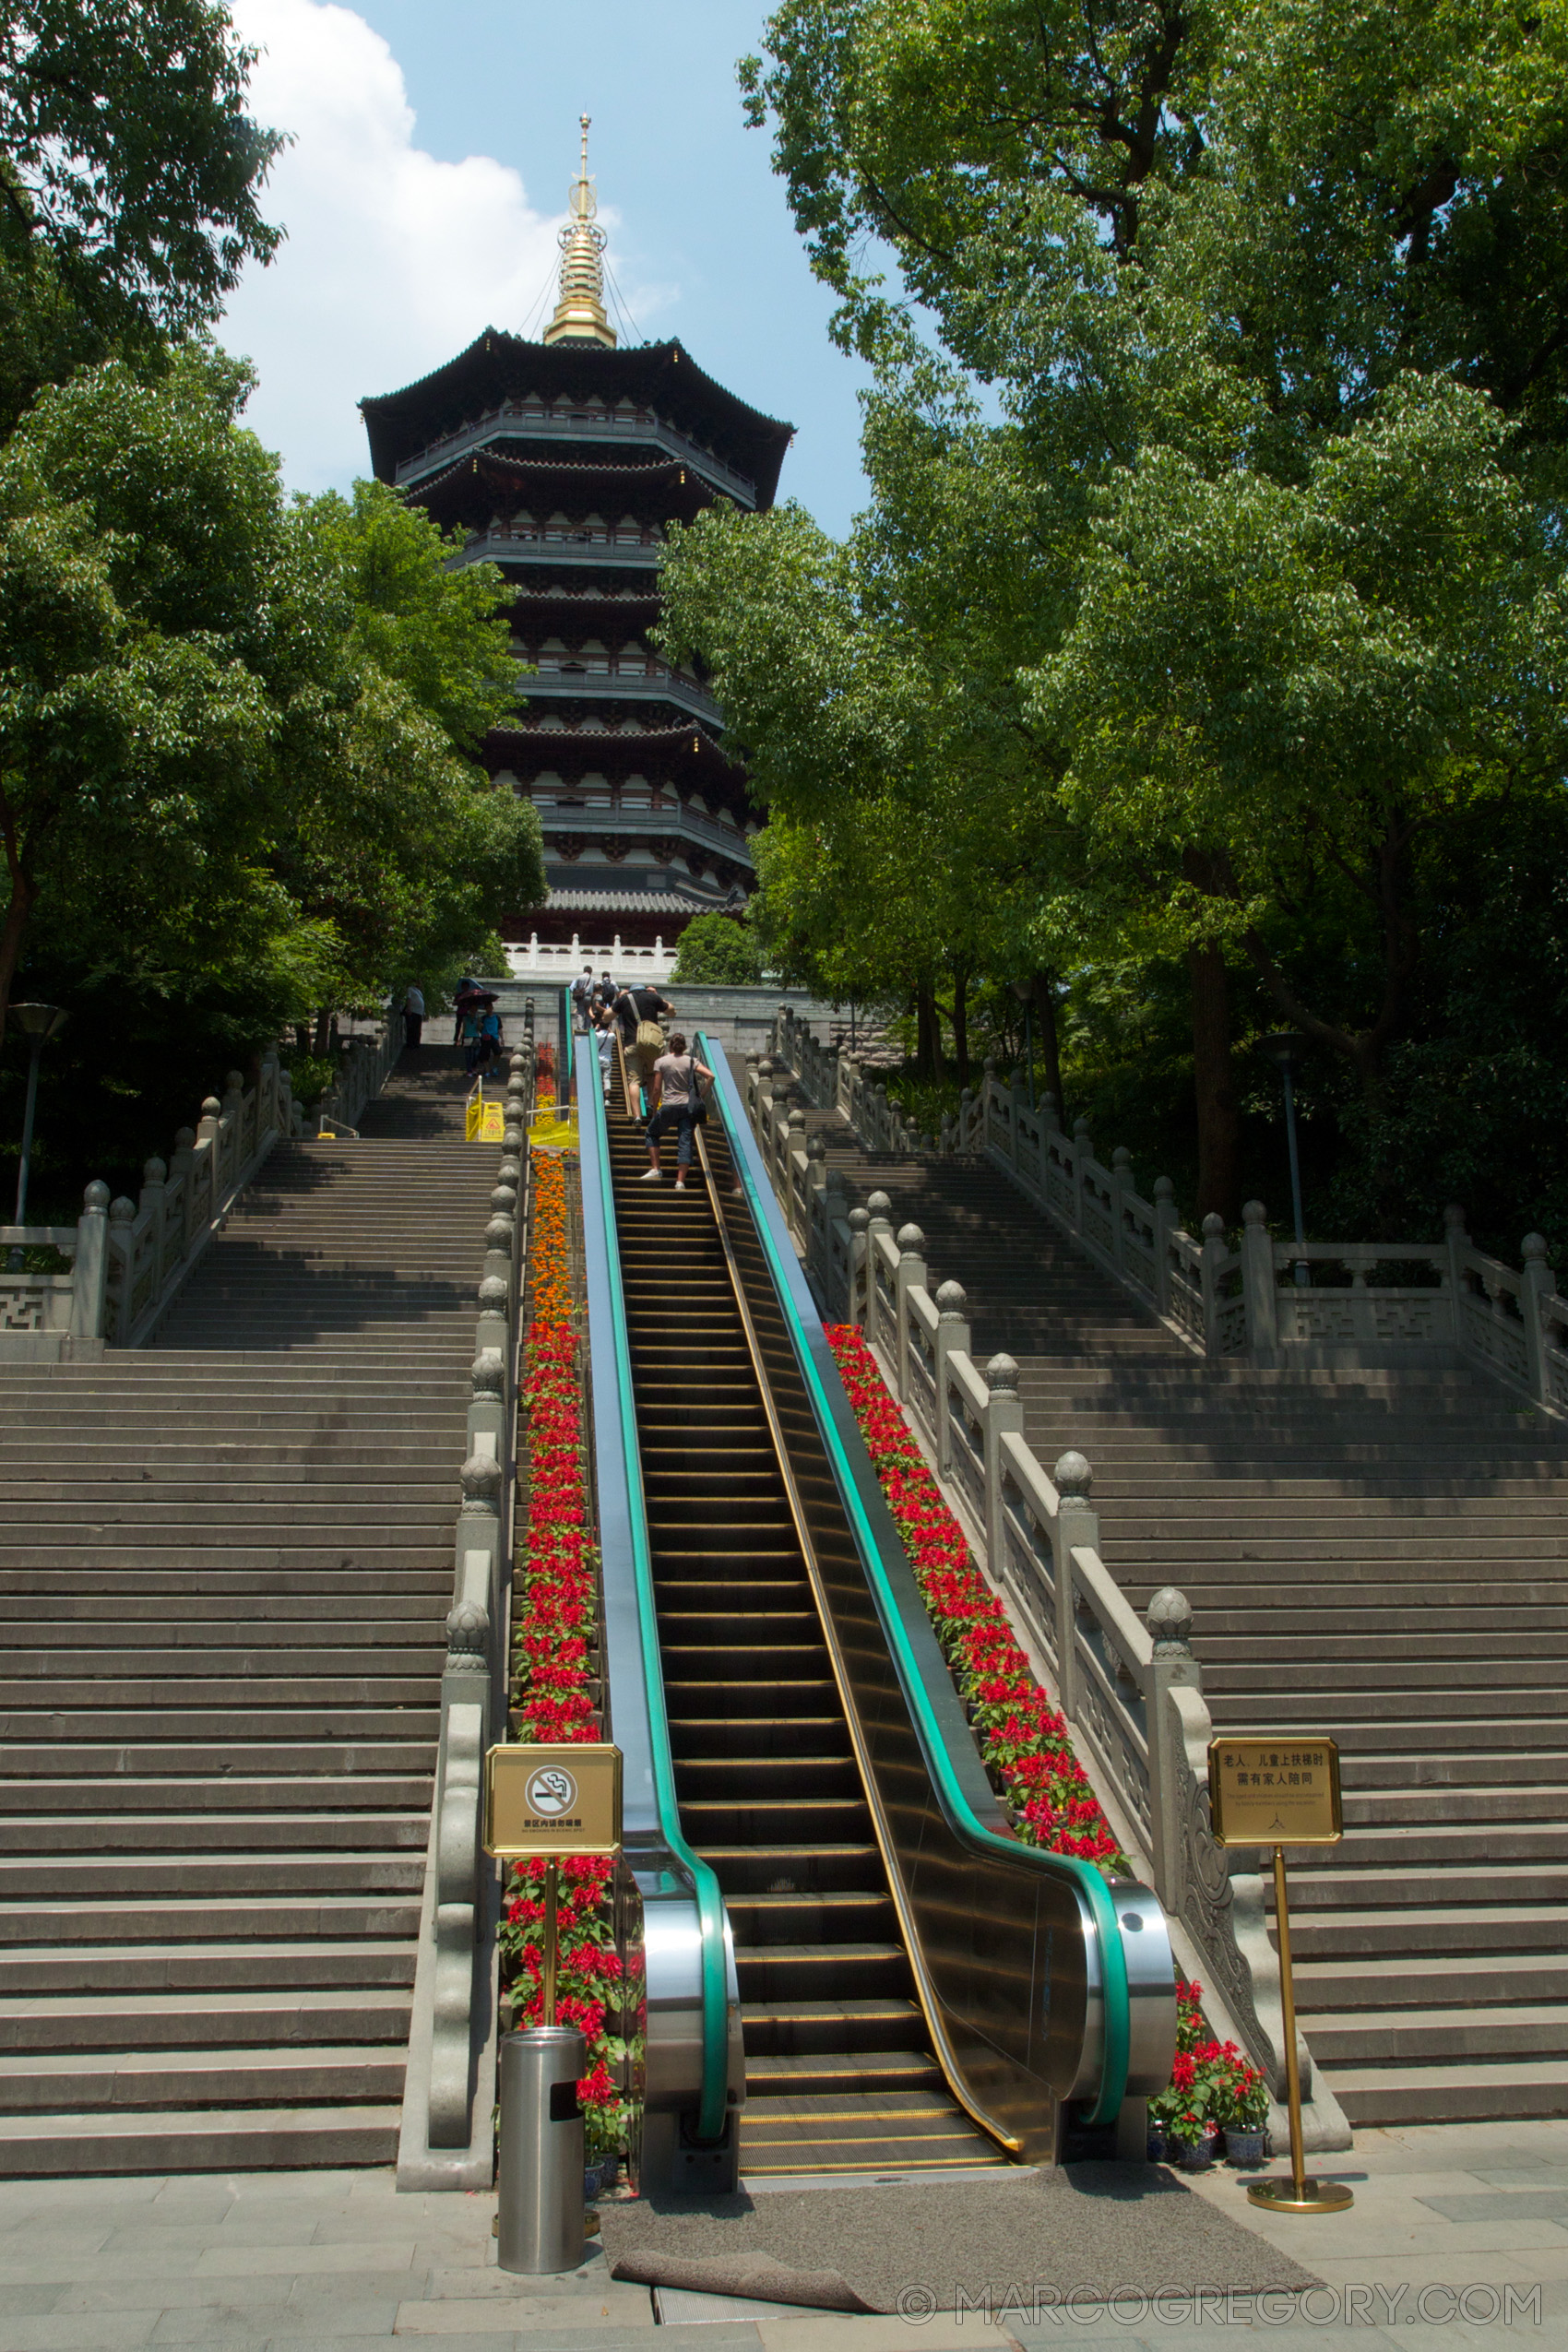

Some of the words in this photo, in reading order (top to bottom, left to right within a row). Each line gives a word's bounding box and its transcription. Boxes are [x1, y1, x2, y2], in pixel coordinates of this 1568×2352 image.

[1223, 1752, 1323, 1767] 老人、儿童上扶梯时
[1237, 1772, 1313, 1786] 需有家人陪同
